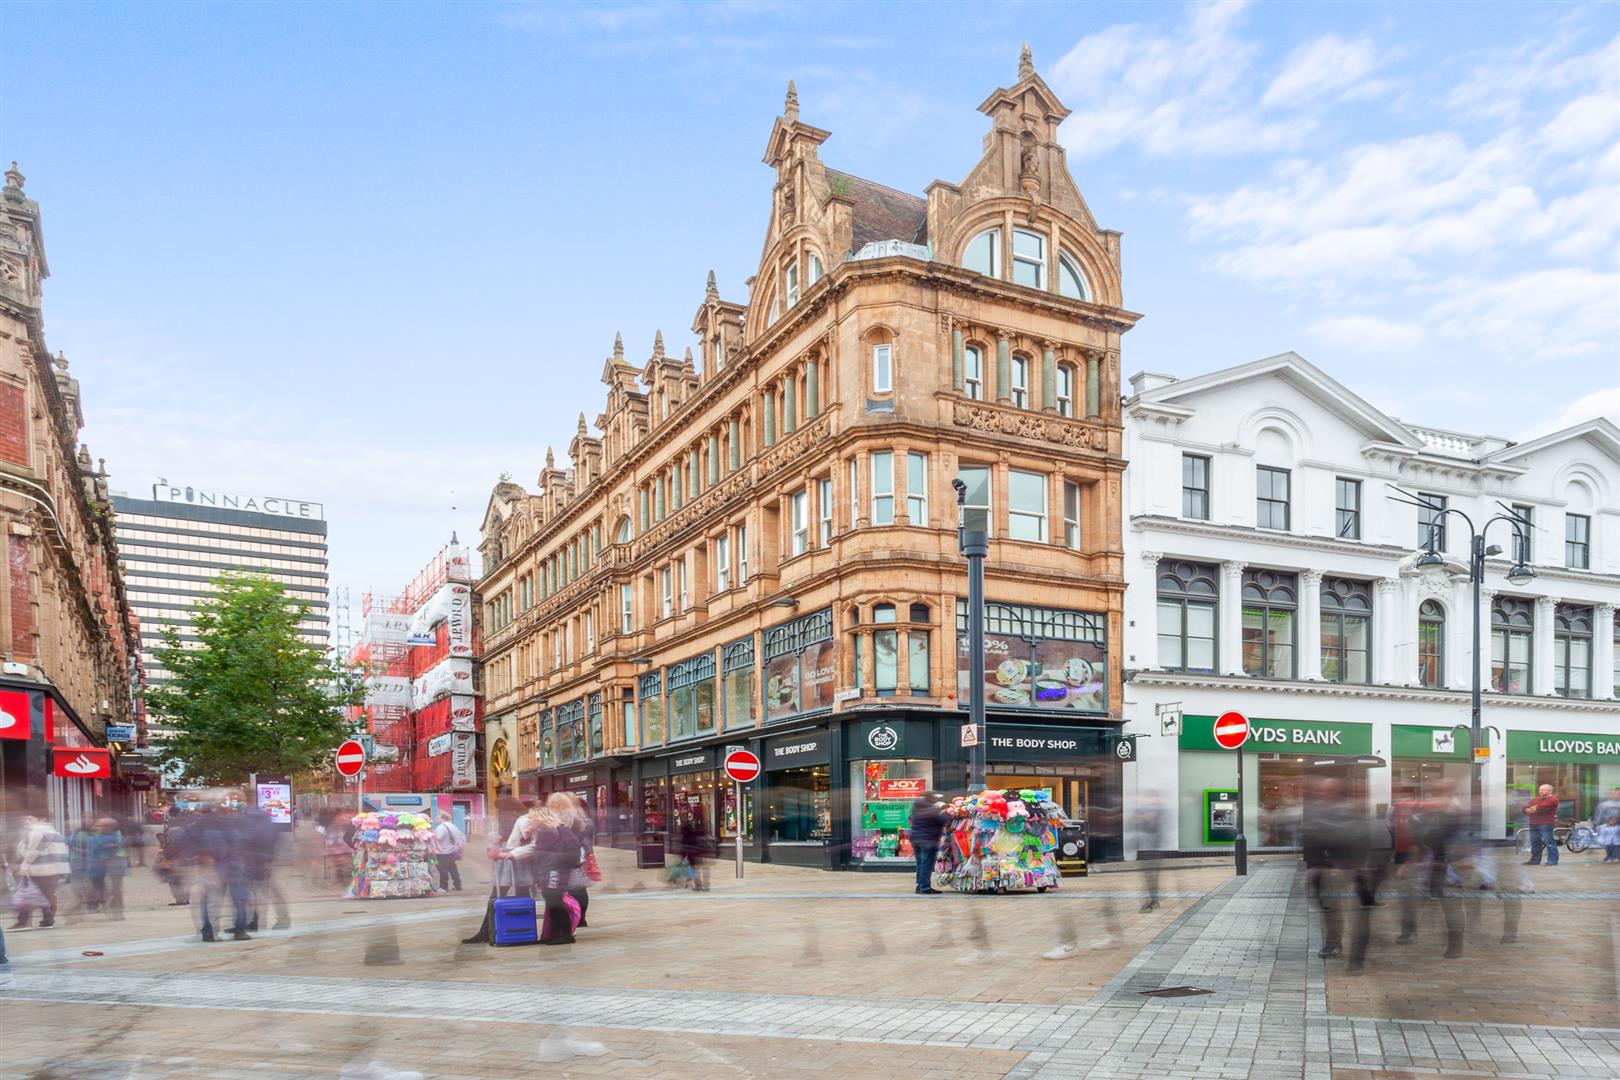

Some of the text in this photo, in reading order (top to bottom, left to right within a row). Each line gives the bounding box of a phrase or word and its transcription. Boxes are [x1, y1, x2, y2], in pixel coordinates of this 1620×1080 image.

[170, 486, 310, 517] PINNACLE
[991, 737, 1016, 747] THE
[1016, 739, 1046, 749] BODY
[1292, 729, 1342, 745] BANK
[774, 747, 785, 756] THE
[785, 744, 800, 755] BODY
[1539, 739, 1593, 754] LLOYDS
[675, 759, 683, 767] THE
[683, 758, 693, 766] BODY
[887, 780, 919, 788] JOY
